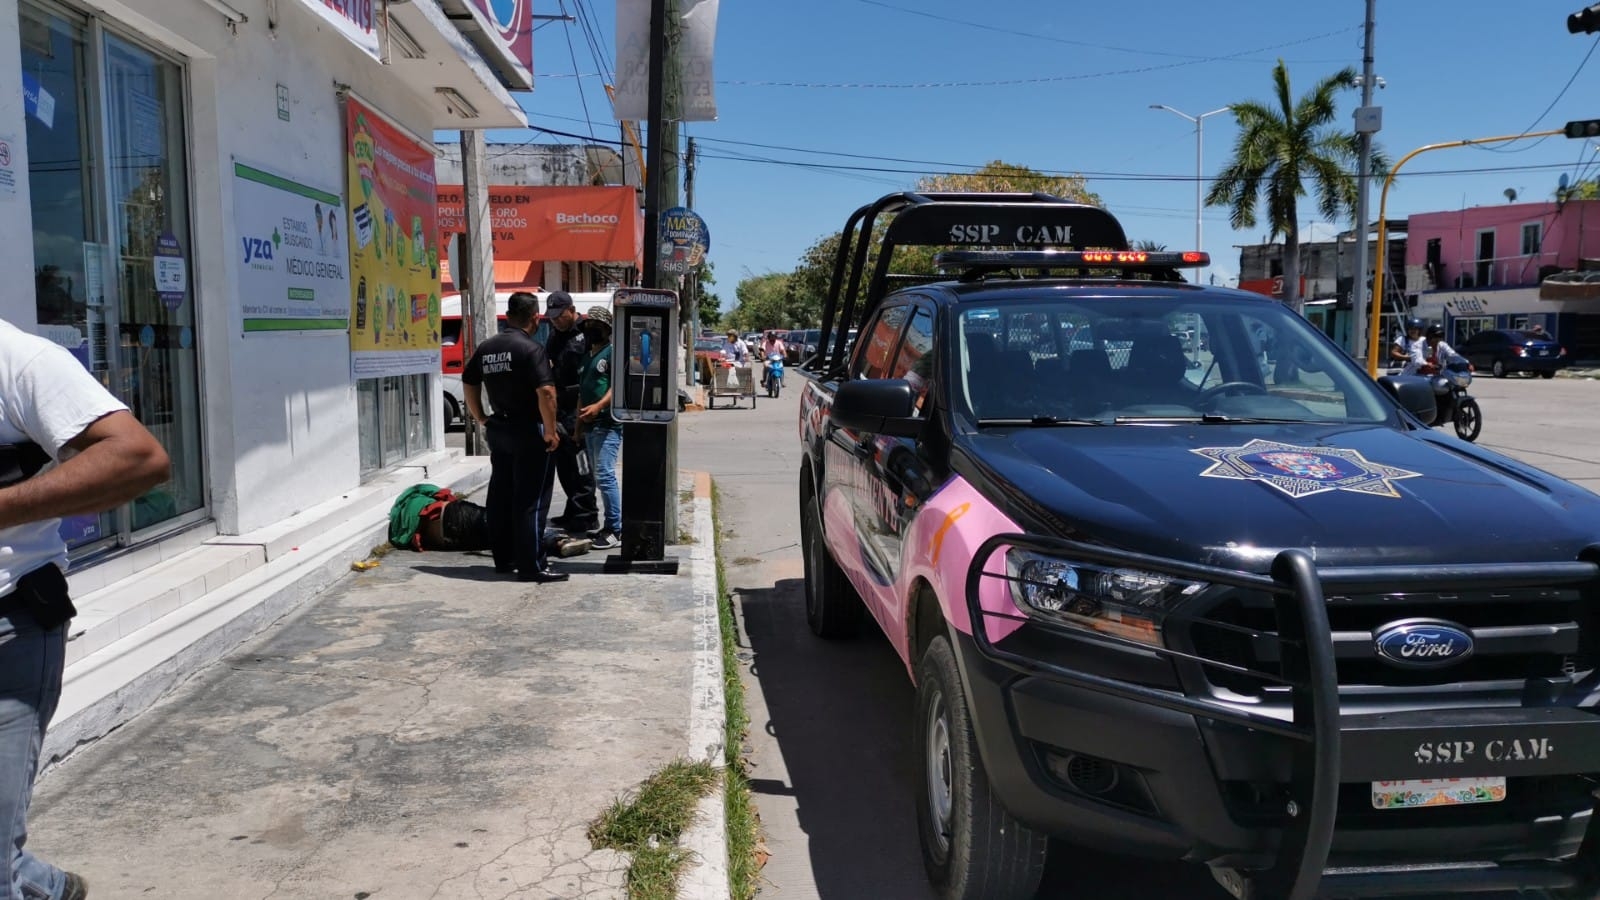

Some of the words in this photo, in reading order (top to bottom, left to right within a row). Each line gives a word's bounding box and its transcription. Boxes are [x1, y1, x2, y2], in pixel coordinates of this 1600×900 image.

[515, 195, 530, 204] EN
[496, 207, 518, 217] ORO
[556, 212, 619, 224] Bachoco
[282, 216, 309, 234] ESTAMOS
[457, 218, 464, 228] Y
[283, 232, 313, 249] BUSCANDO
[500, 231, 515, 241] VA
[949, 224, 1000, 243] SSP
[1016, 225, 1072, 244] CAM
[242, 236, 273, 264] yza
[286, 256, 315, 278] MÉDICO
[315, 261, 344, 280] GENERAL
[663, 262, 683, 272] SMS
[1453, 295, 1482, 312] telcel
[1400, 632, 1453, 657] Ford
[1417, 740, 1475, 765] SSP
[1485, 737, 1549, 762] CAM
